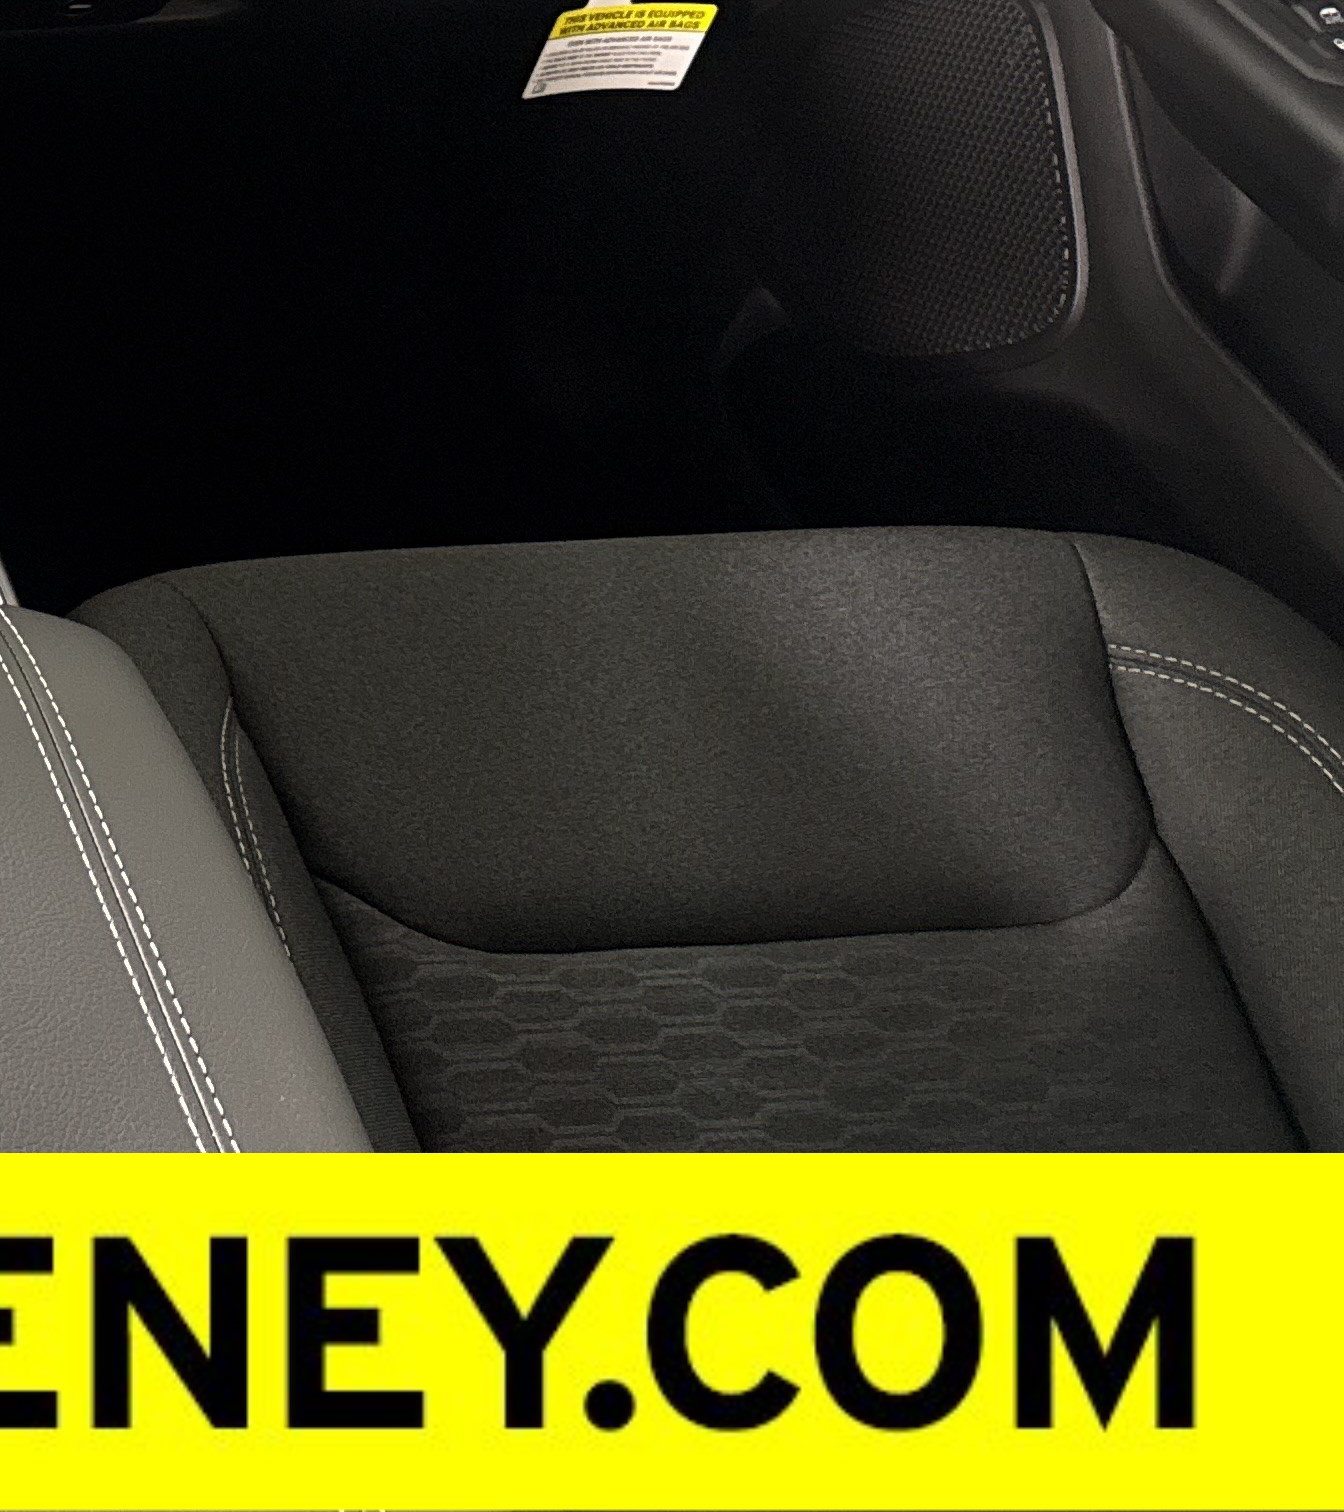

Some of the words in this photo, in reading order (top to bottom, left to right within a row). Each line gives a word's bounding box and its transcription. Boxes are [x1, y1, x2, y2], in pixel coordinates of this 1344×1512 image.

[564, 13, 587, 26] THIS
[588, 9, 634, 22] VEHICLE
[635, 9, 647, 19] IS
[648, 9, 706, 20] EQUIPPED
[559, 24, 586, 36] WITH
[585, 20, 646, 32] ADVANCED
[647, 19, 668, 29] AIR
[668, 19, 701, 30] BAGS
